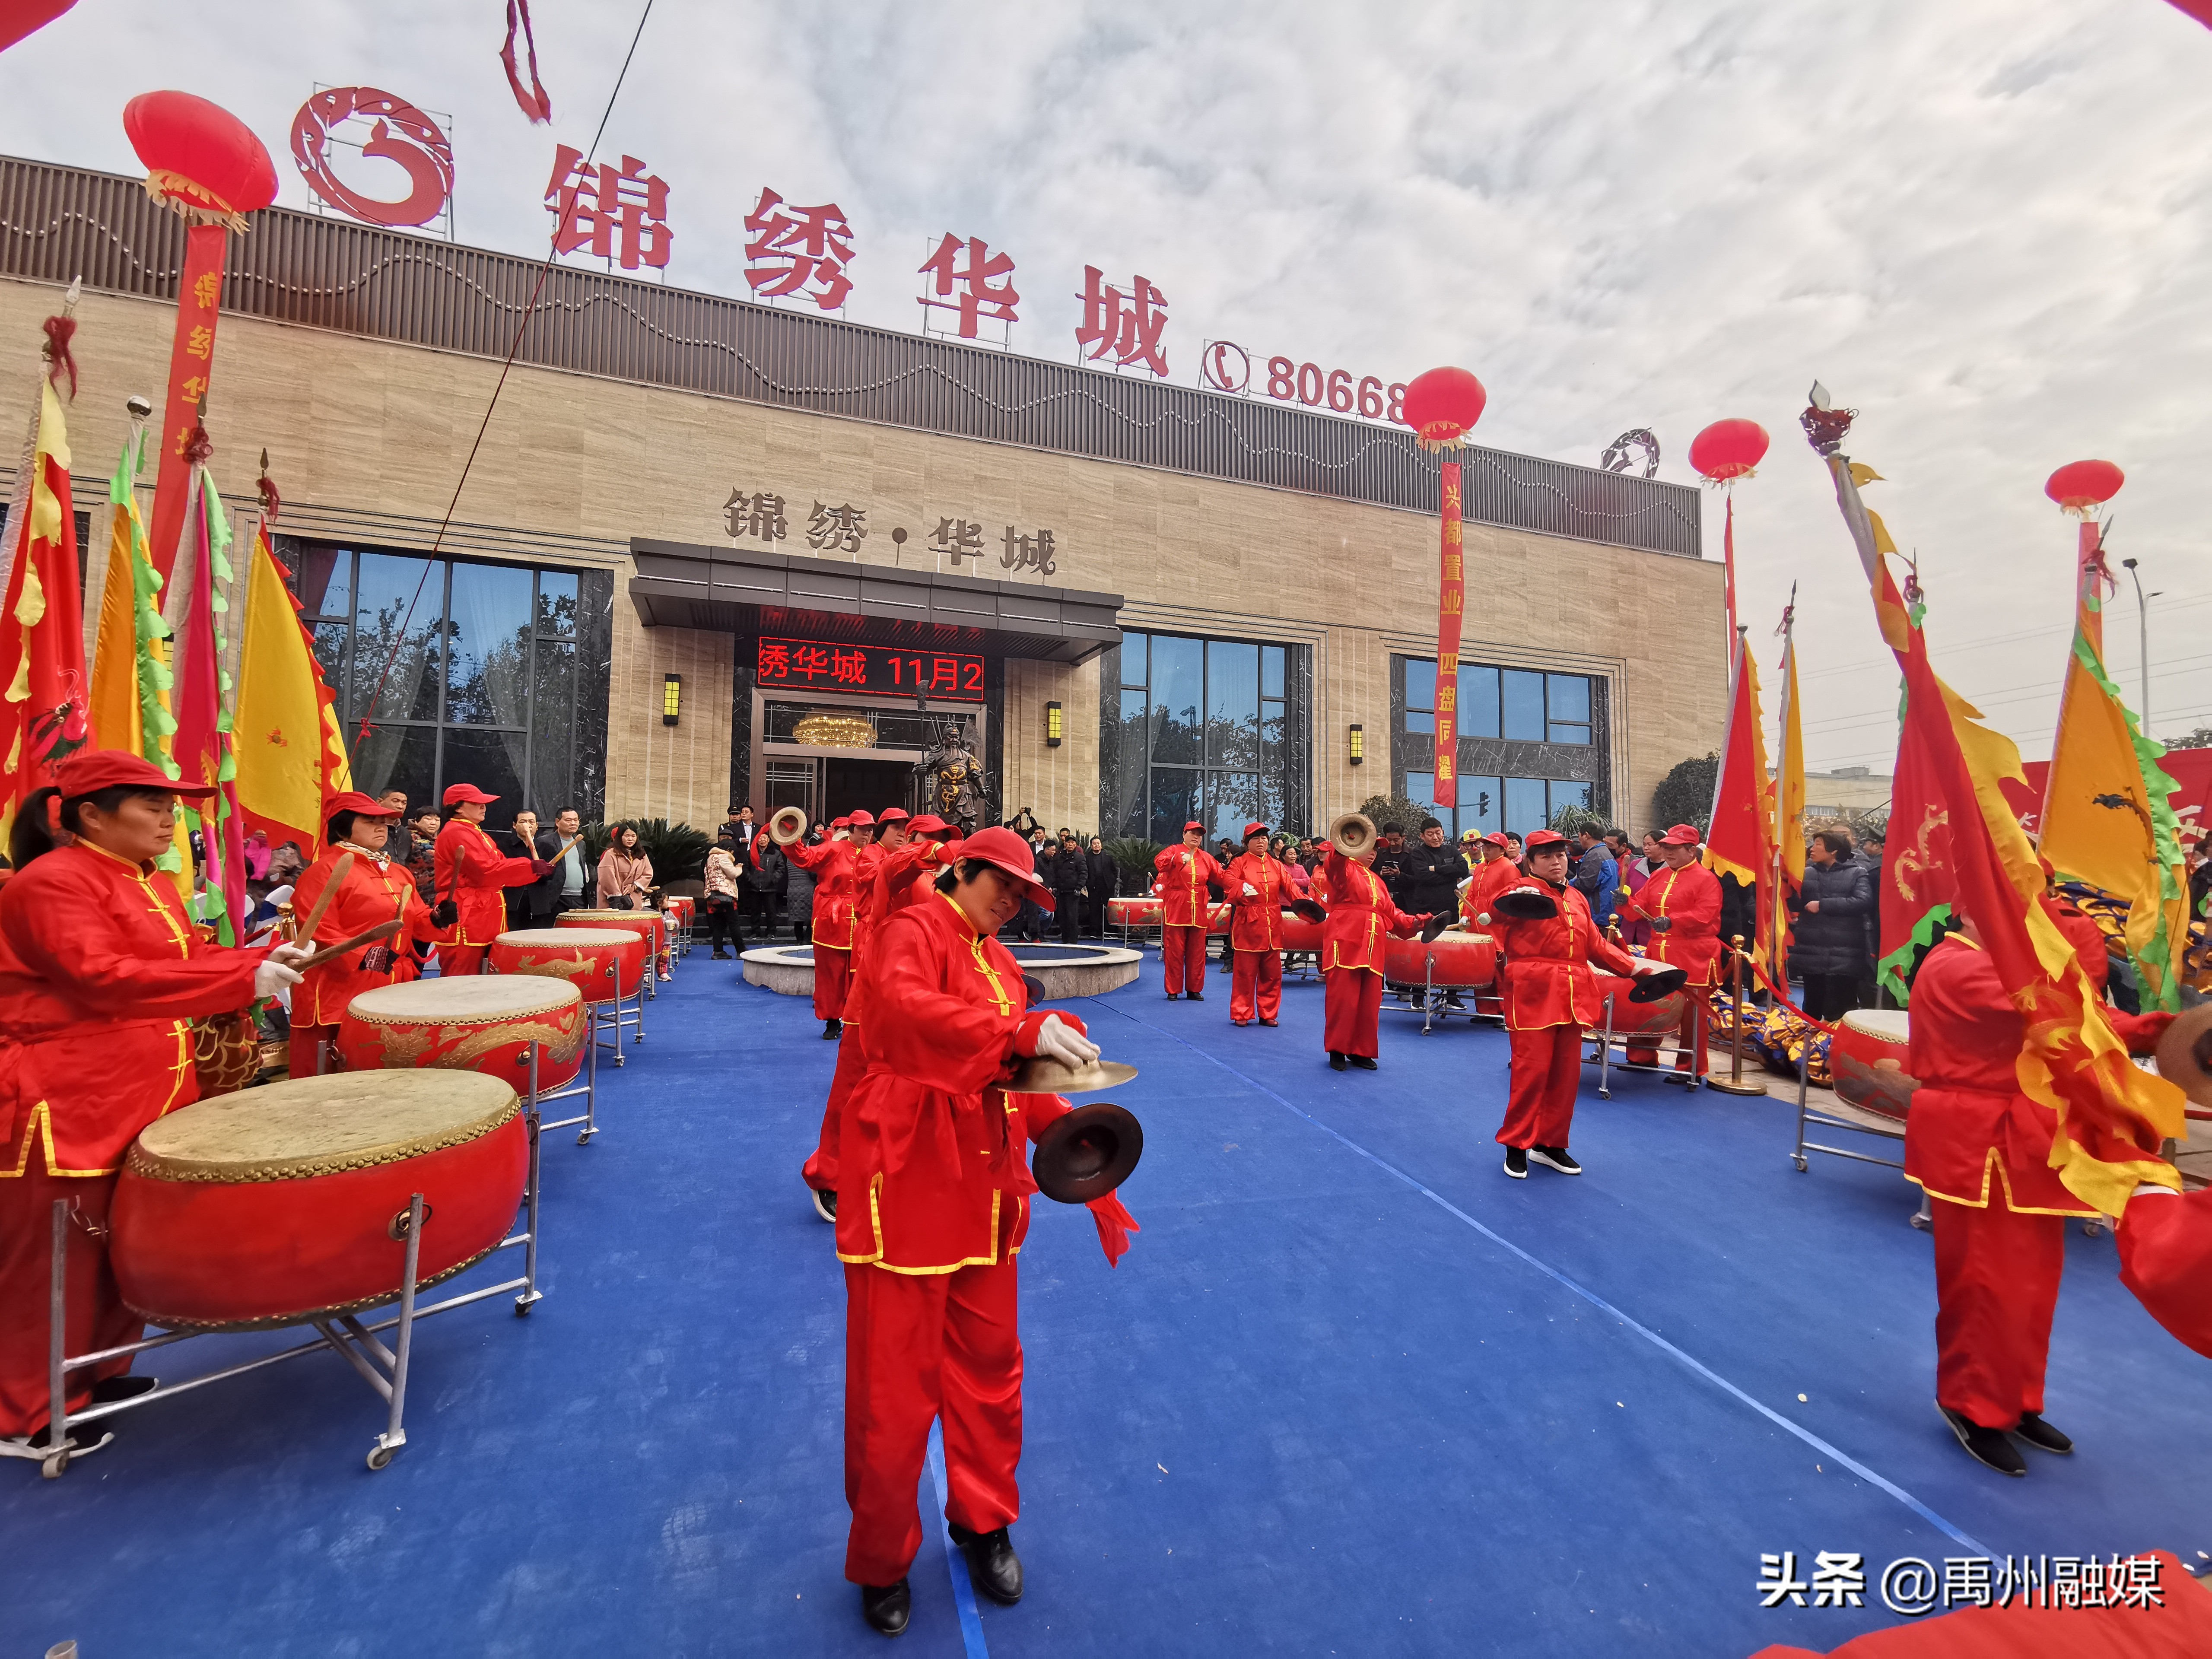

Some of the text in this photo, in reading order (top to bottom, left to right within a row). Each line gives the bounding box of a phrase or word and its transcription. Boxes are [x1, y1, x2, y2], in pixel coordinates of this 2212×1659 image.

[543, 143, 1169, 377] 锦绣华城
[1441, 484, 1462, 616] 兴都置业
[760, 645, 982, 691] 绣华城 11月2
